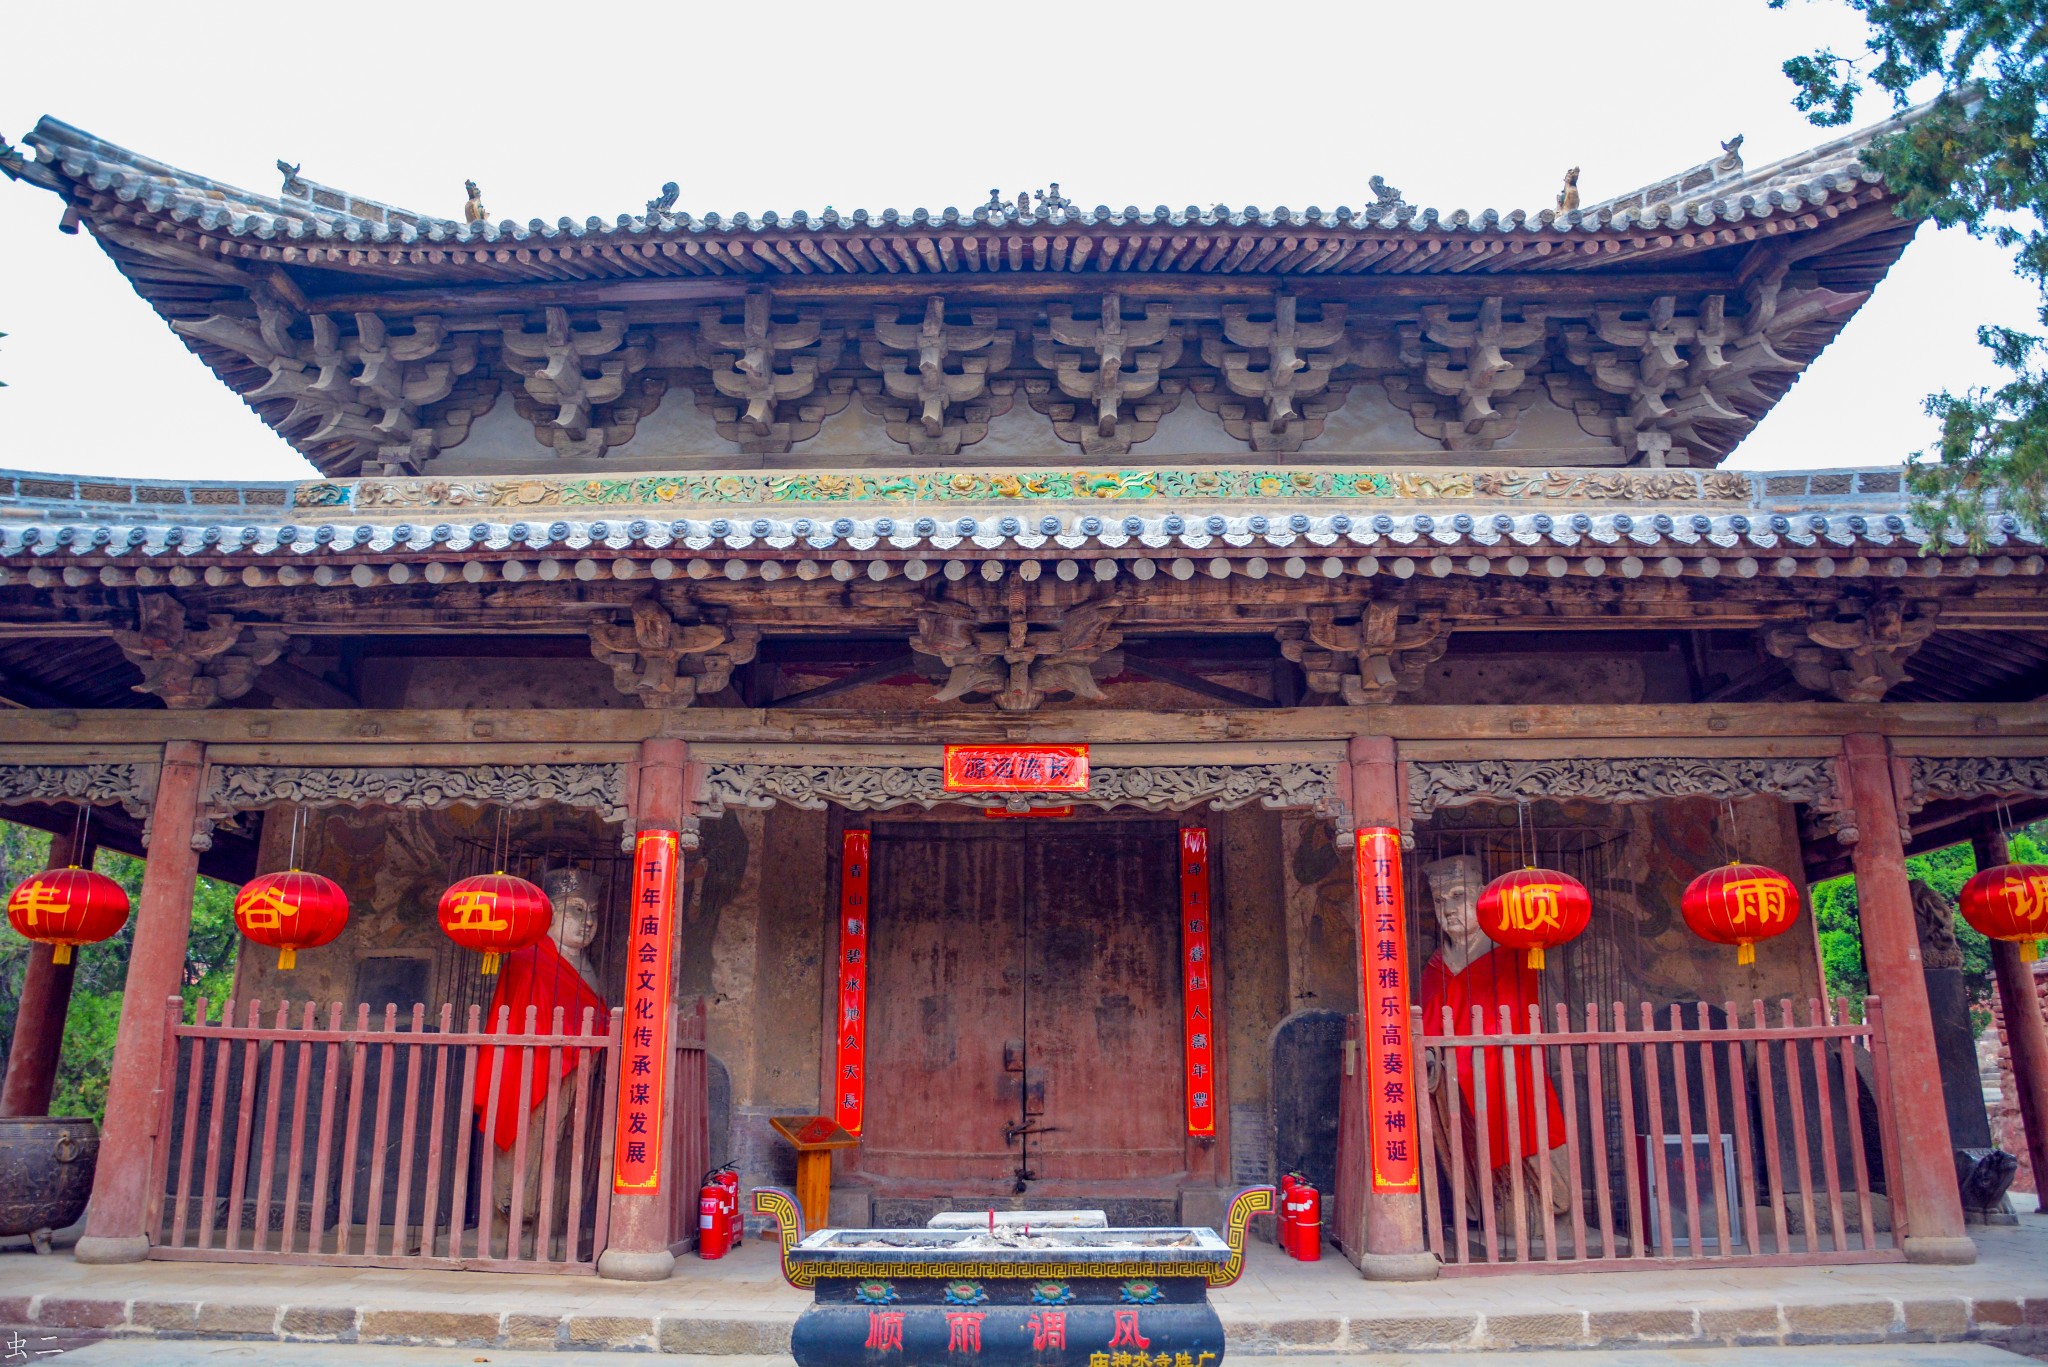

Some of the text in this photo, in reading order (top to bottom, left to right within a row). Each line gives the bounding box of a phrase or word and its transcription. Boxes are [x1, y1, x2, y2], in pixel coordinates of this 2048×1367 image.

[963, 756, 1070, 780] 源远流长
[8, 880, 71, 926] 丰
[236, 886, 299, 930] 谷
[446, 890, 509, 932] 五
[1497, 883, 1563, 931] 顺
[1722, 877, 1789, 924] 雨
[625, 860, 663, 1164] 千年庙会文化传承谋发展
[1372, 858, 1408, 1162] 万民云集雅乐高奏祭神诞
